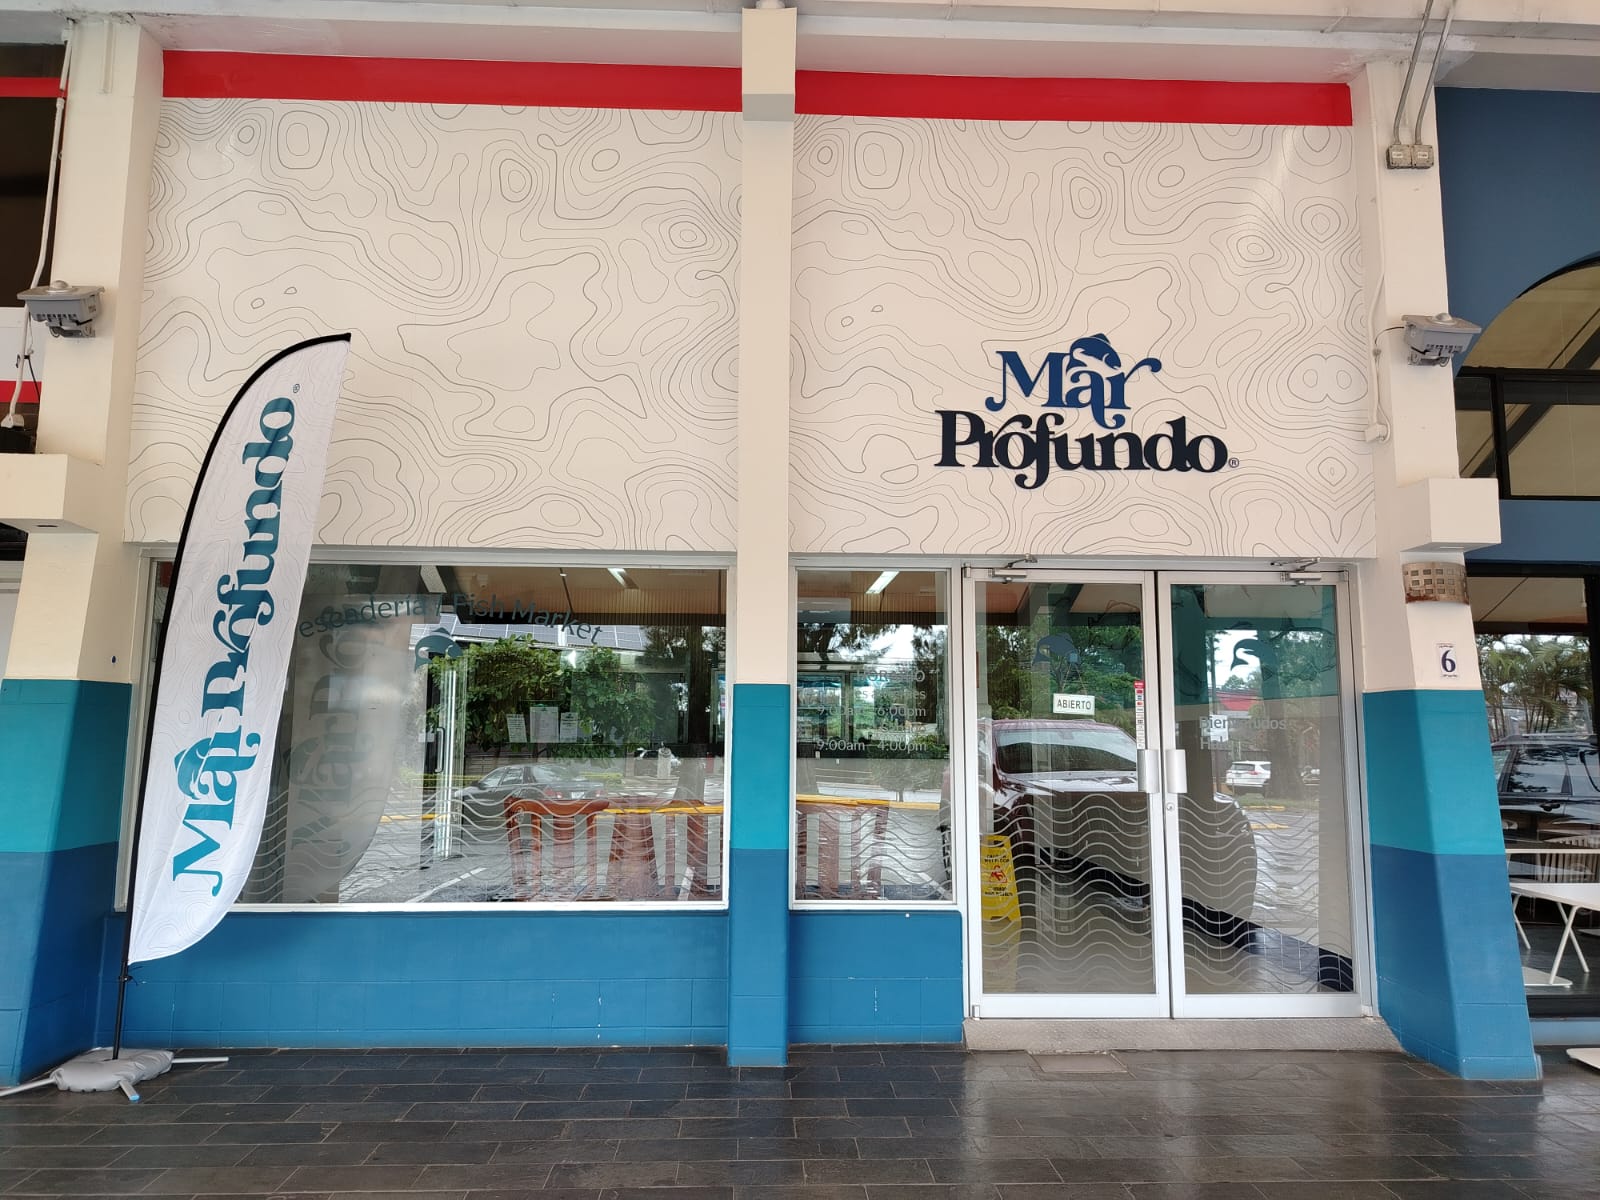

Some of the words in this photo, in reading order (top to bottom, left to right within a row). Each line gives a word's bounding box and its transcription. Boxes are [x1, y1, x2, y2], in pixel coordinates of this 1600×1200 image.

[985, 350, 1162, 430] Mar
[454, 592, 505, 619] Fish
[512, 599, 604, 645] Market
[1441, 649, 1456, 673] 6
[1057, 699, 1092, 710] ABIERTO
[817, 739, 865, 751] 9:00am
[877, 740, 927, 754] 4:00pm
[172, 711, 261, 897] Mar
